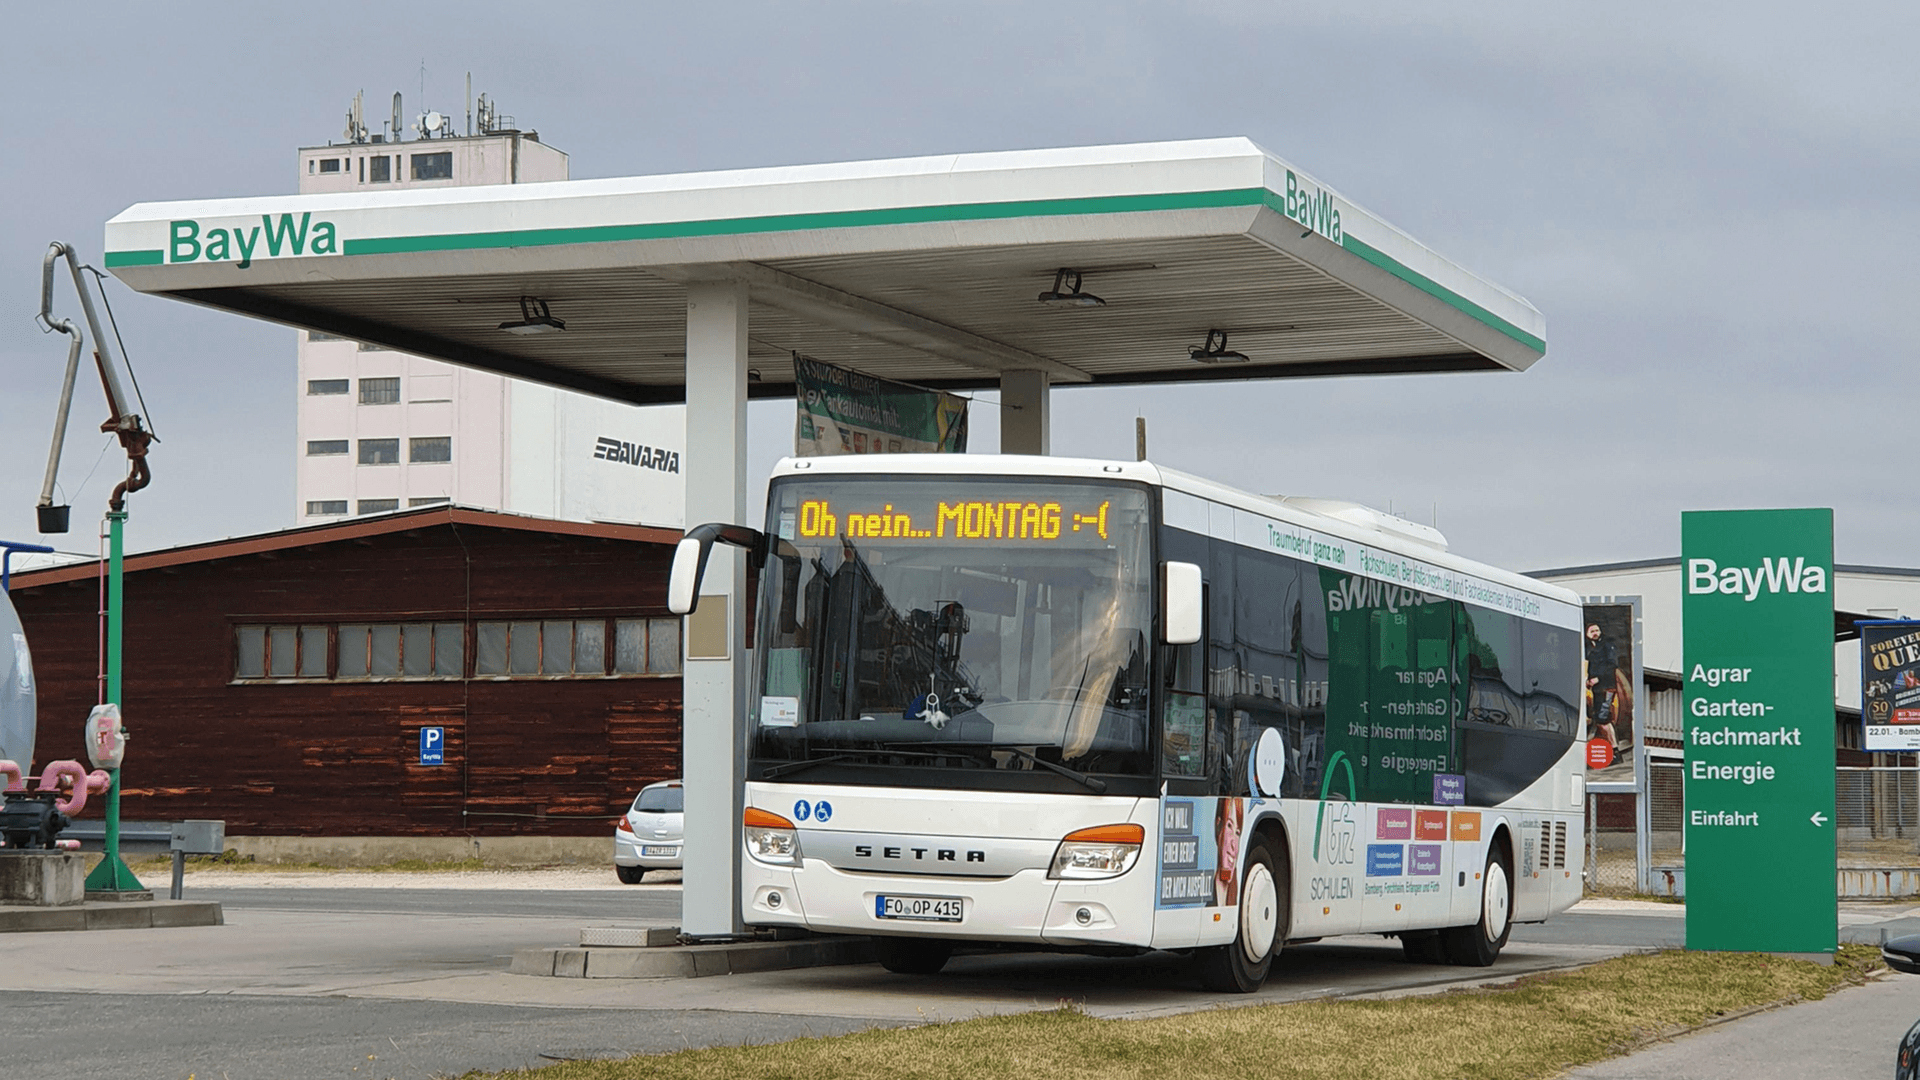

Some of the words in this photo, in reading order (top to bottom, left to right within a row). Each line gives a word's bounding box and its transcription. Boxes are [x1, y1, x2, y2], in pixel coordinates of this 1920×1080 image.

[1286, 168, 1341, 244] BayWa
[170, 212, 338, 269] BayWa
[594, 436, 680, 475] BAVARIA
[800, 501, 837, 537] Oh
[936, 502, 1062, 539] MONTAG
[1072, 501, 1109, 540] :-(
[1267, 523, 1312, 556] Traumberuf
[1313, 541, 1331, 563] ganz
[1331, 543, 1346, 565] nah
[1688, 557, 1827, 602] BayWa
[1690, 663, 1752, 687] Agrar
[1691, 697, 1774, 717] Garten-
[1872, 701, 1889, 713] 50
[426, 729, 440, 748] P
[1691, 726, 1802, 746] fachmarkt
[1869, 728, 1893, 736] 22.01.
[1691, 760, 1775, 785] Energie
[1691, 810, 1759, 827] Einfahrt
[855, 845, 985, 862] SETRA
[1310, 877, 1354, 900] SCHULEN
[885, 899, 903, 914] FO
[912, 900, 930, 915] OP
[934, 901, 960, 916] 415
